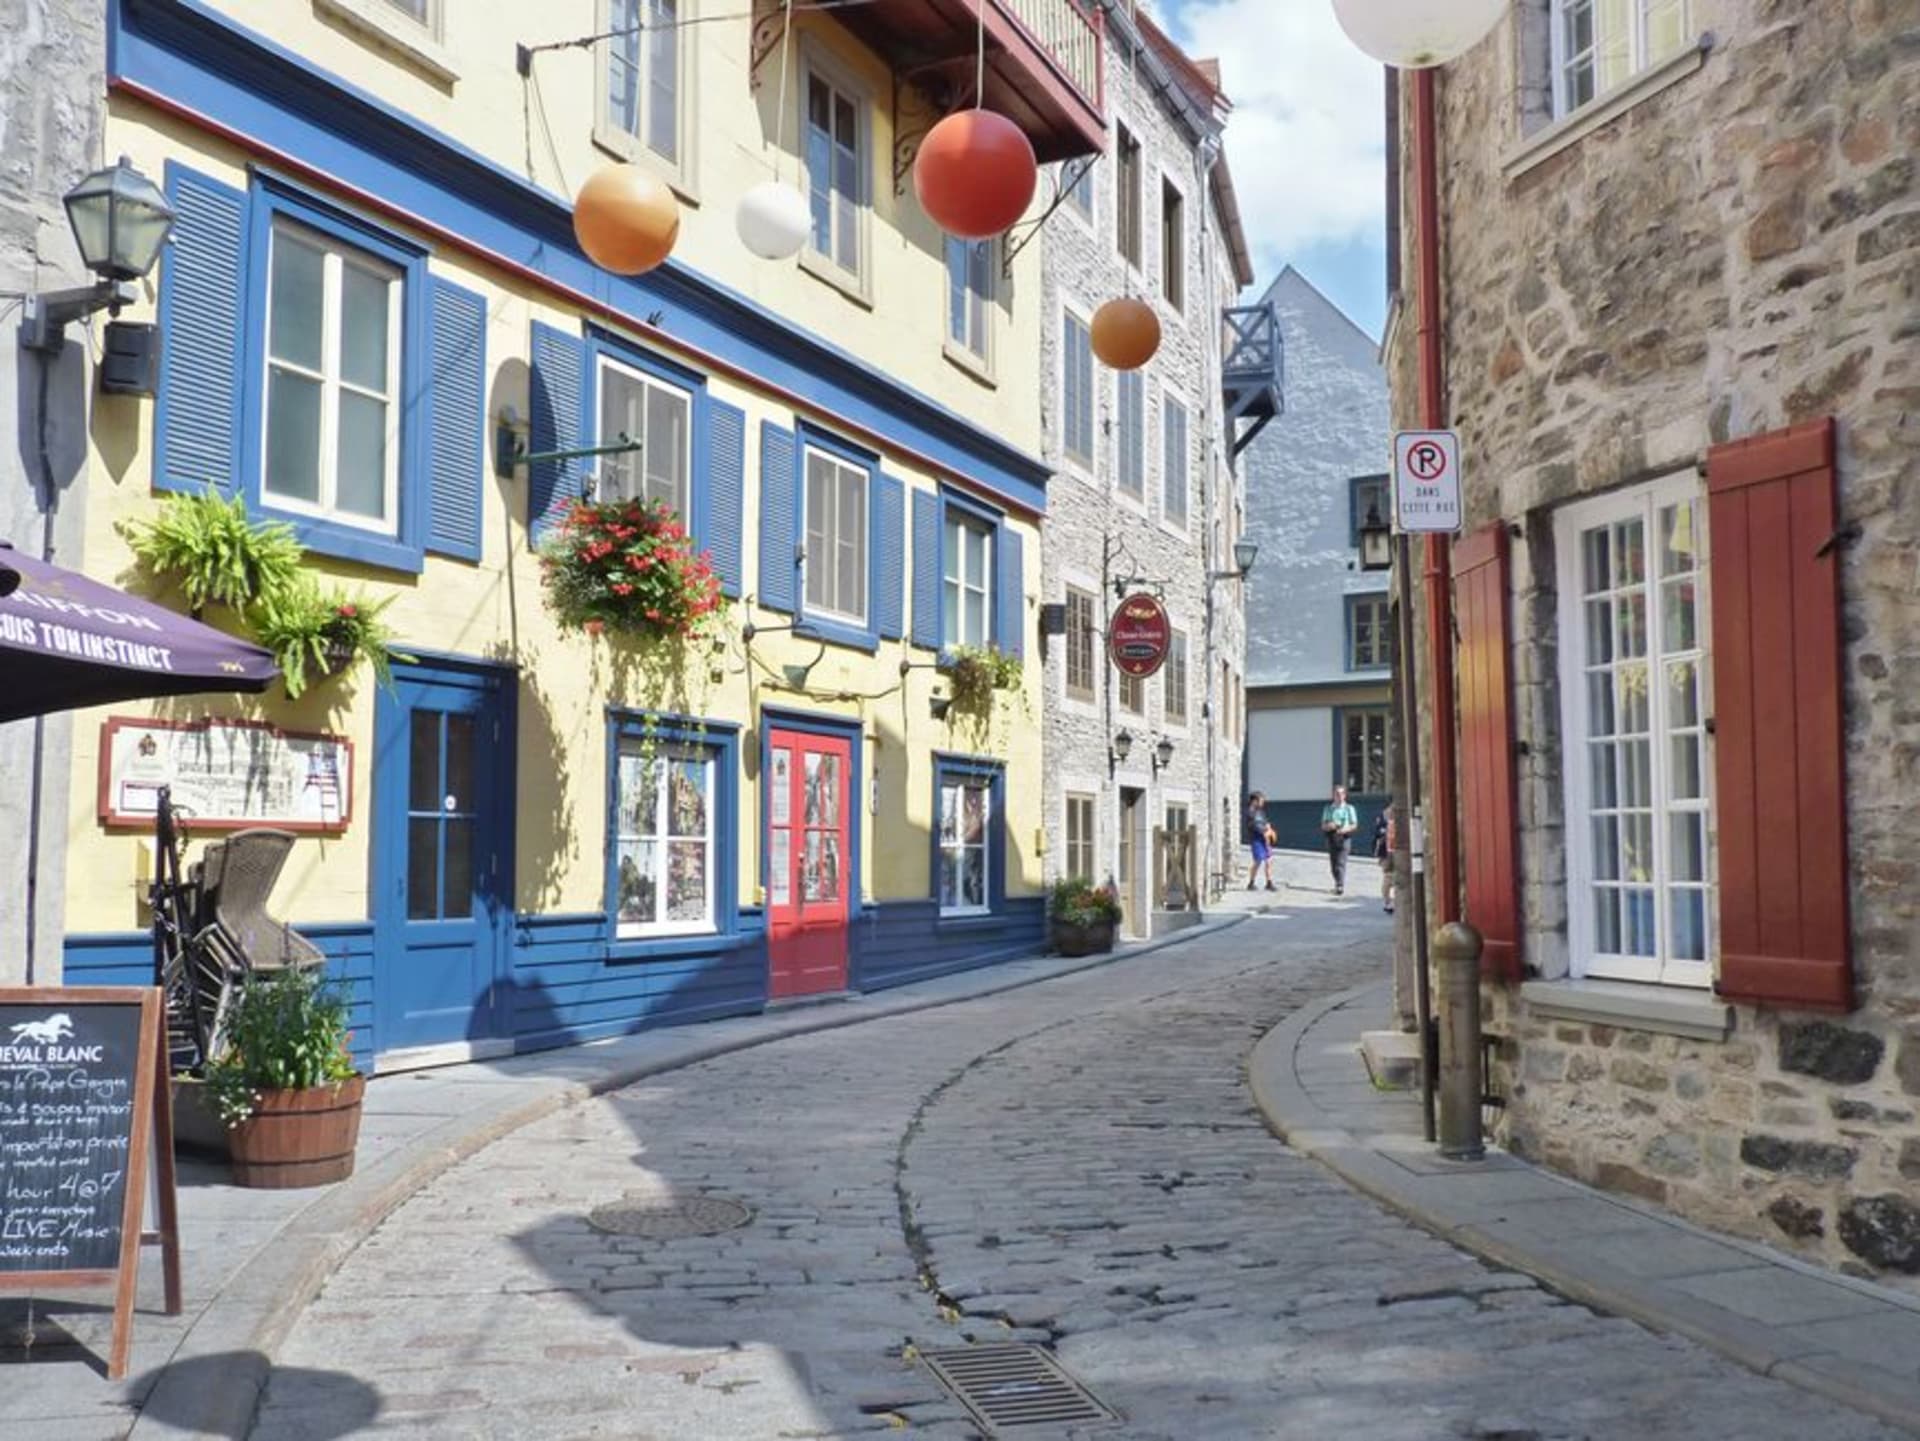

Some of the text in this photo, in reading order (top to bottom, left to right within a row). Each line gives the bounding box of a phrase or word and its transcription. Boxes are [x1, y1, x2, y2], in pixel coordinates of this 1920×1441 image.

[40, 622, 81, 652] TON
[81, 632, 173, 670] INSTINCT
[0, 1045, 104, 1062] EVAL BLANC
[6, 1171, 120, 1200] hour 4@7
[2, 1218, 58, 1238] LIVE
